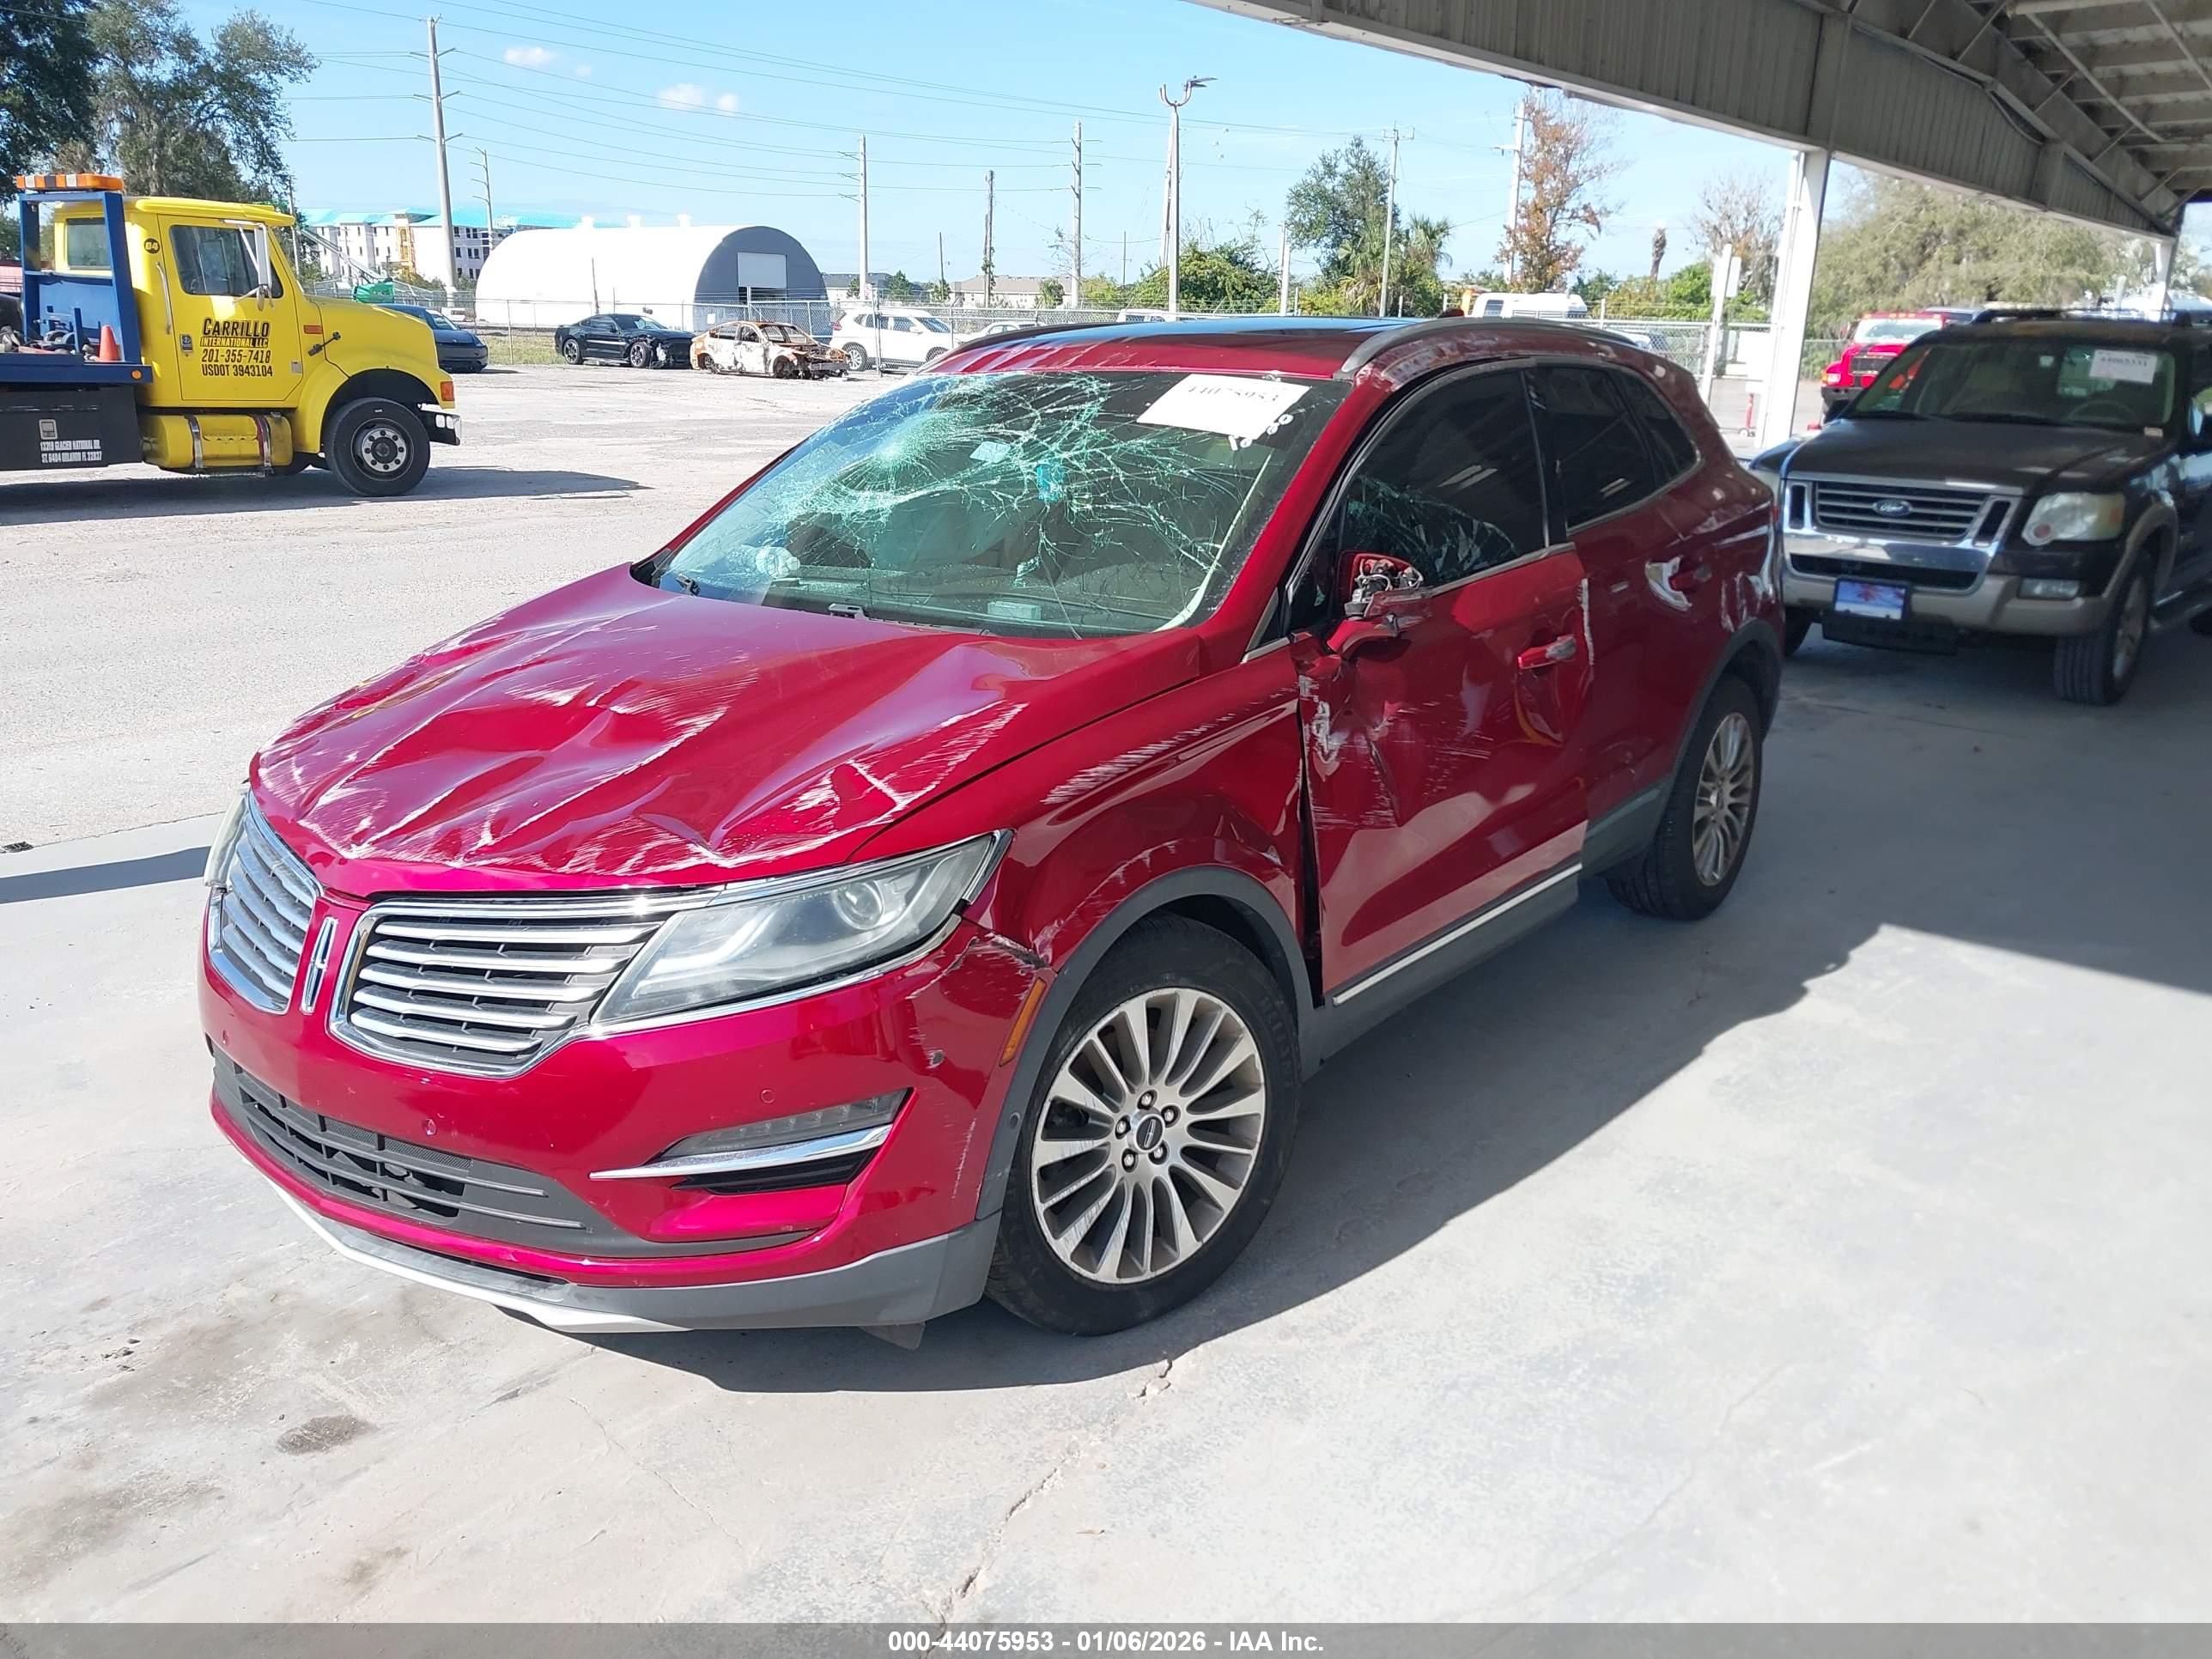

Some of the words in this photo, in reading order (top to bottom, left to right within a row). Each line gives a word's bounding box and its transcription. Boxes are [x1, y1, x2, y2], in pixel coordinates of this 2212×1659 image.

[203, 318, 270, 337] CARRILLO
[201, 337, 253, 348] INTERNATIONAL
[254, 337, 269, 348] LLC
[201, 348, 271, 363] 201-355-7418
[201, 363, 230, 376] USDOT
[232, 364, 273, 377] 3943104
